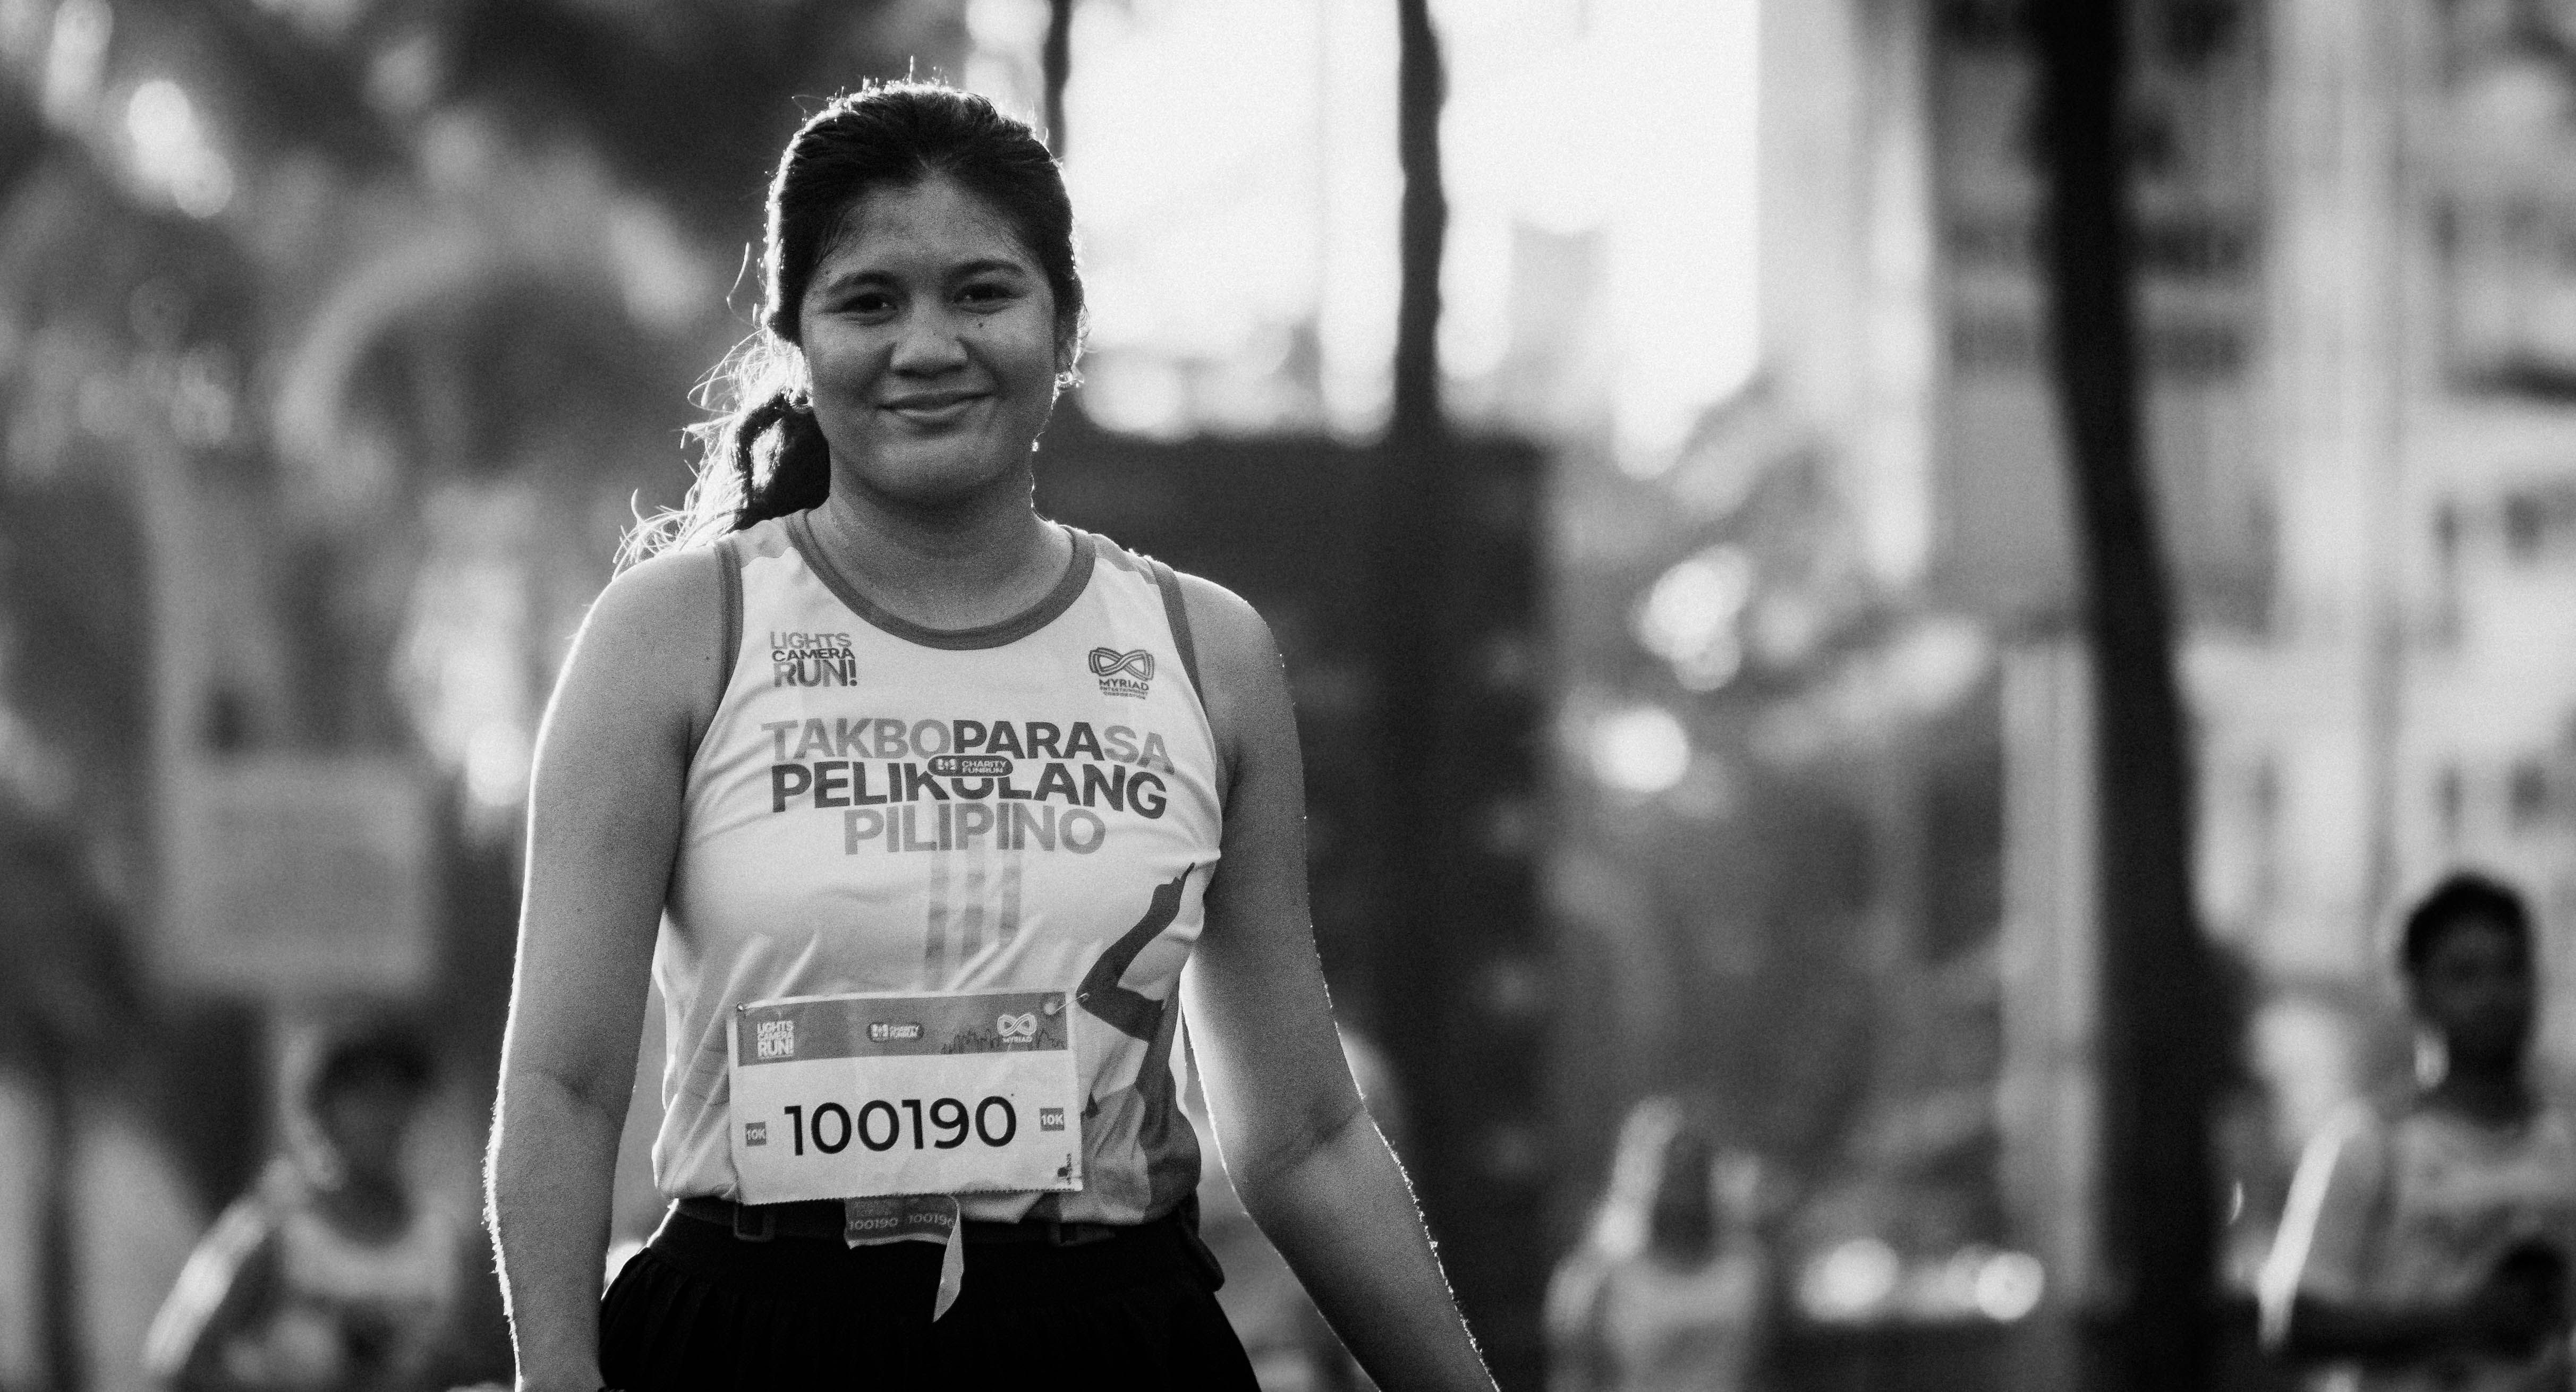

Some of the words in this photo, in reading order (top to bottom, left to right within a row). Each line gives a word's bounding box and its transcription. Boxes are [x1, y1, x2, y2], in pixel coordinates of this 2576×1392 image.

[770, 631, 852, 650] LIGHTS
[772, 647, 855, 662] CAMERA
[773, 659, 857, 687] RUN!
[1099, 679, 1149, 691] MYRIAD
[844, 802, 1106, 855] PILIPINO
[757, 1020, 794, 1034] LIGHTS
[747, 1128, 766, 1140] 10K
[784, 1096, 1016, 1156] 100190
[1041, 1114, 1064, 1125] 10K
[849, 1217, 898, 1231] 100190
